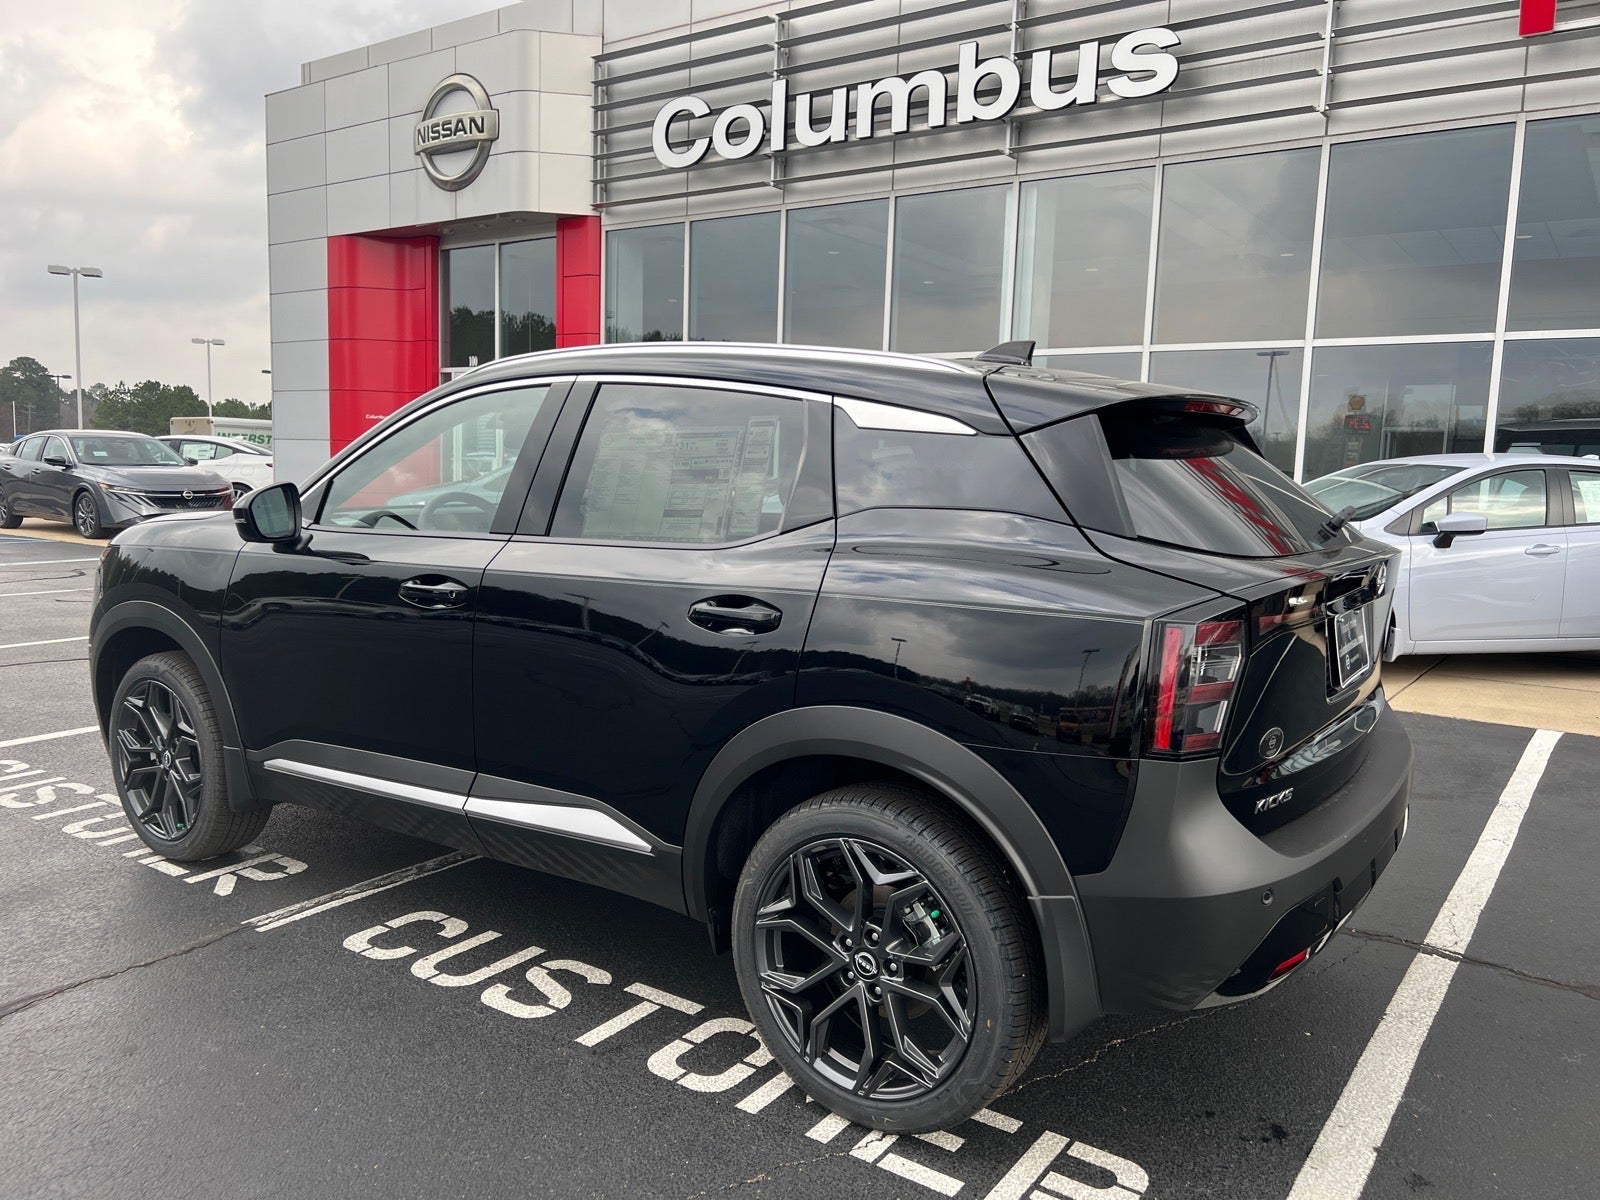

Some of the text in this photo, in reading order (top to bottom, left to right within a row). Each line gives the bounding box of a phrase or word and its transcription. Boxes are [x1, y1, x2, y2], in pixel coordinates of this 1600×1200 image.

[651, 27, 1181, 169] Columbus
[417, 116, 485, 146] NISSAN
[1254, 787, 1294, 815] KICKS
[902, 834, 978, 922] BRIDGESTONE
